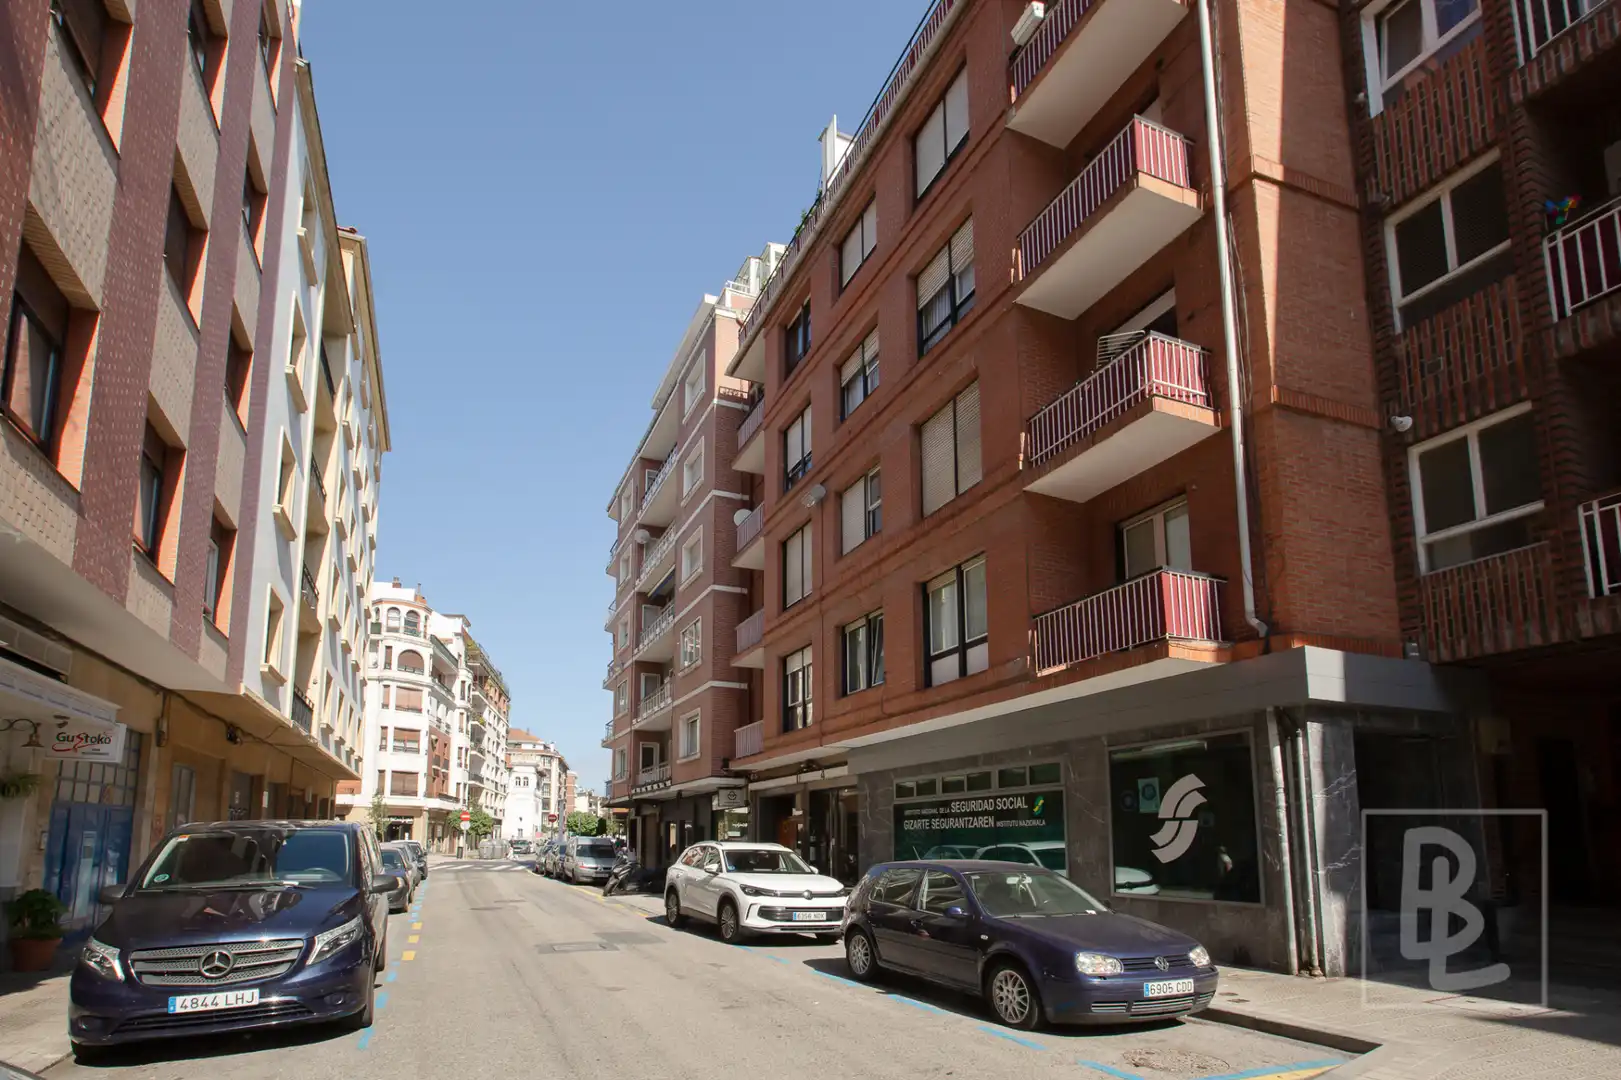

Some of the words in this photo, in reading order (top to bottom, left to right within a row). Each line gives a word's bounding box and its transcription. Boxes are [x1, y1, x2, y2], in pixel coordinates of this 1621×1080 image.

[951, 799, 994, 813] SEGURIDAD
[996, 796, 1028, 810] SOCIAL
[904, 819, 930, 830] GIZARTE
[931, 816, 994, 830] SEGURANTZAREN
[1150, 983, 1173, 995] 6905
[1176, 981, 1192, 993] CDD
[180, 995, 219, 1010] 4844
[225, 991, 255, 1006] LHJ
